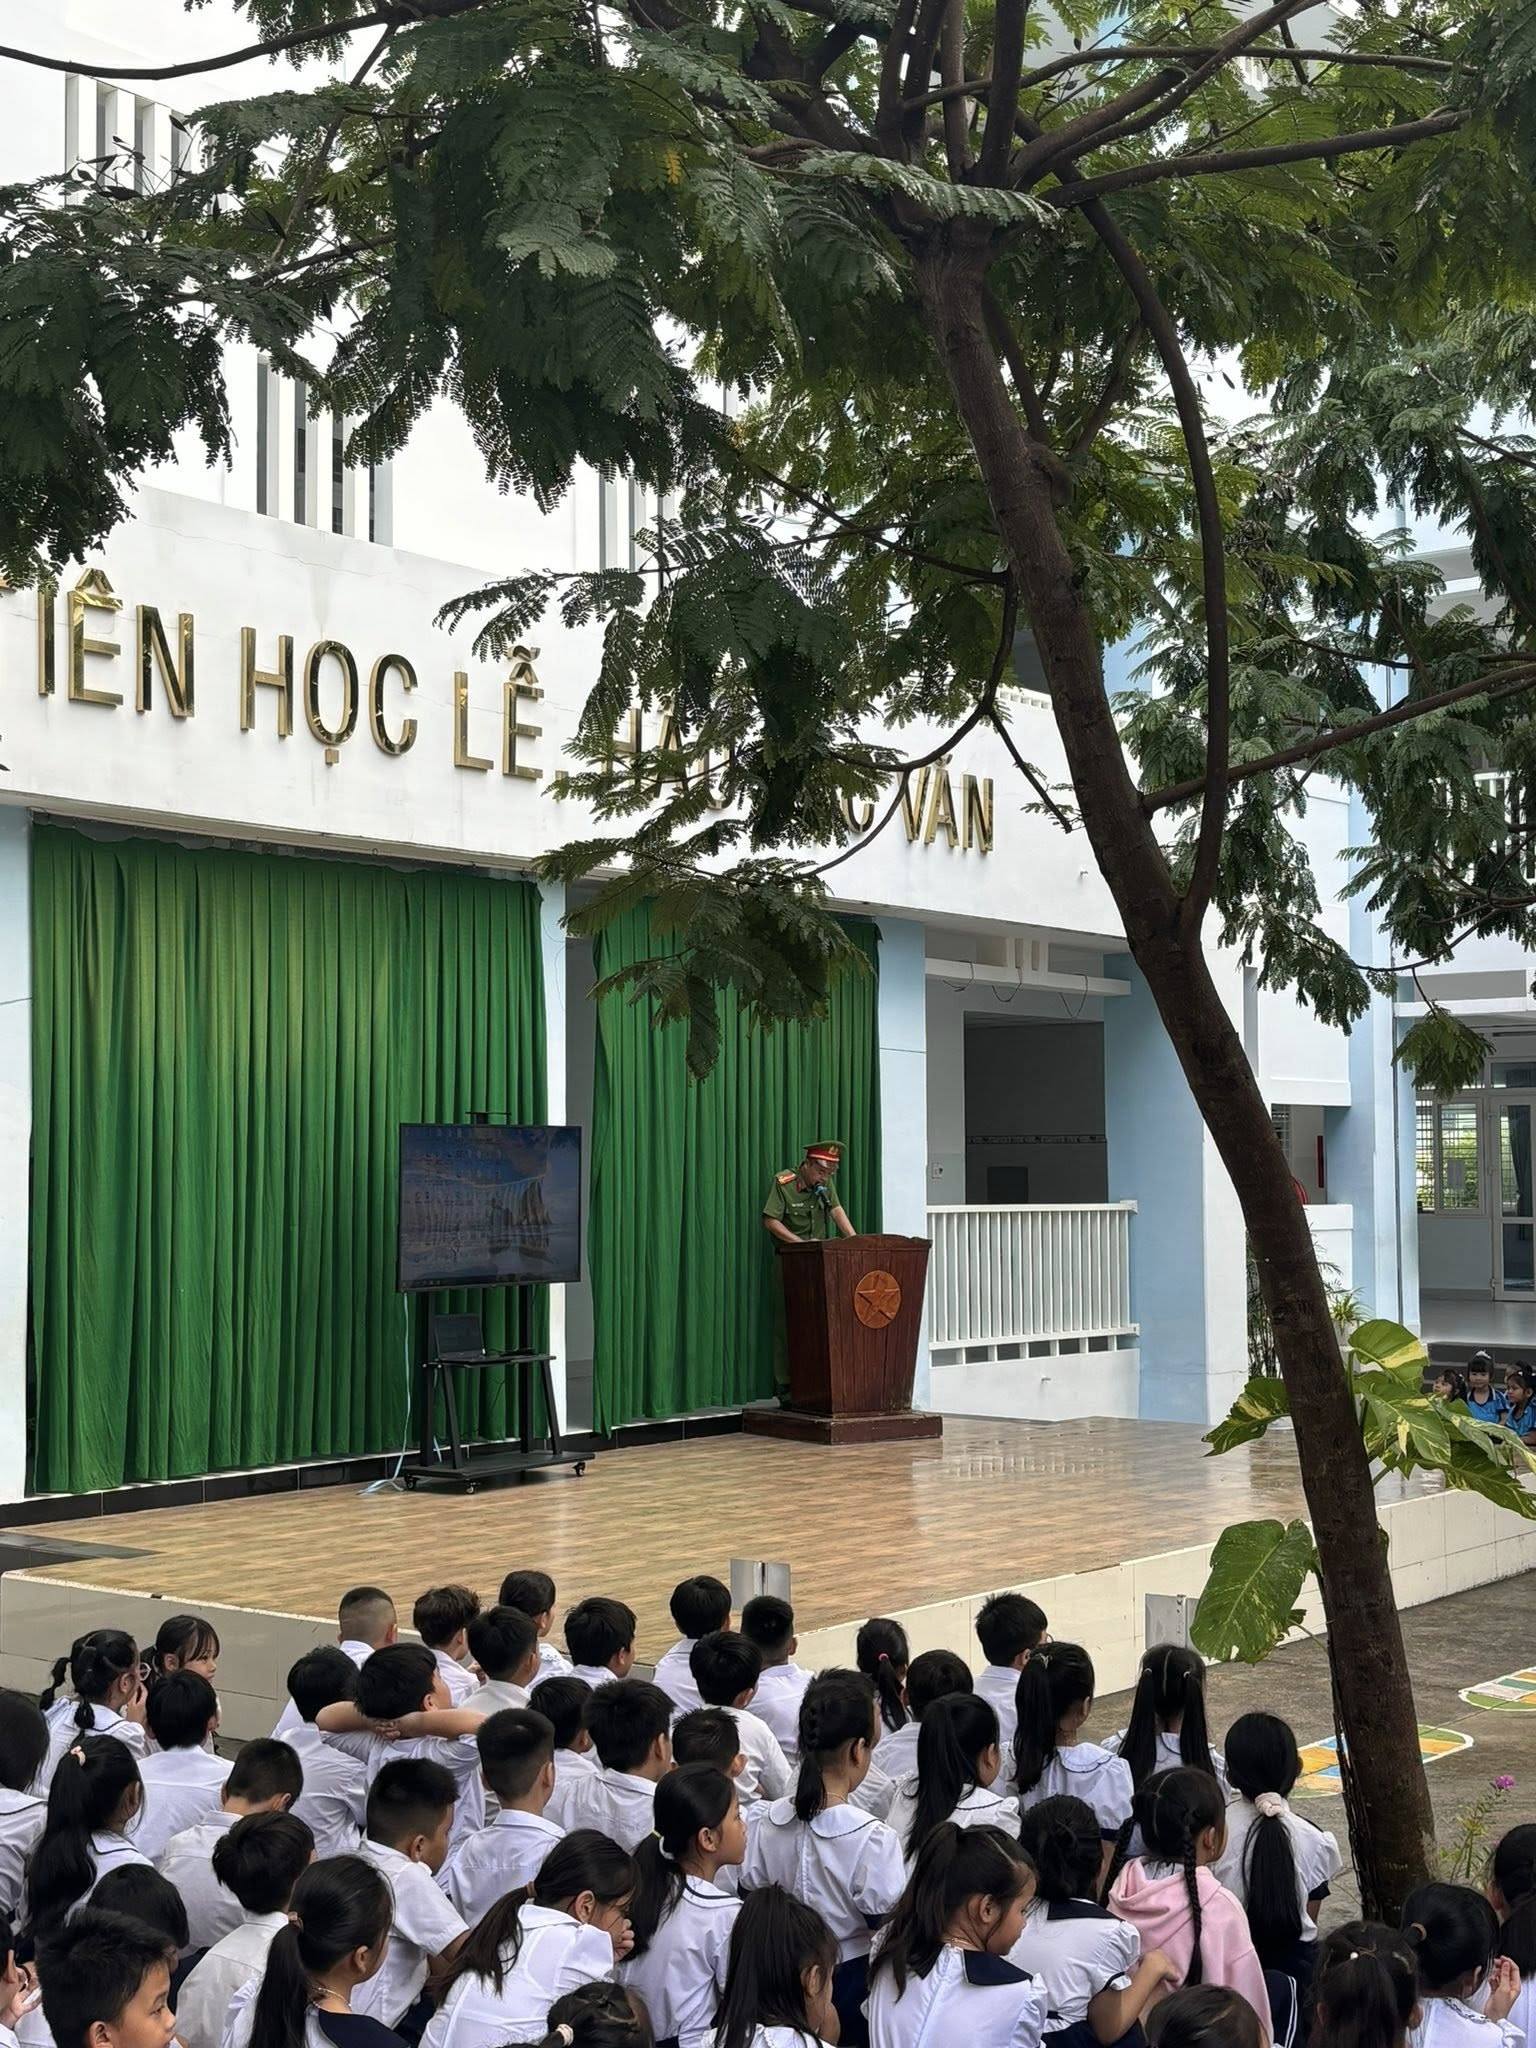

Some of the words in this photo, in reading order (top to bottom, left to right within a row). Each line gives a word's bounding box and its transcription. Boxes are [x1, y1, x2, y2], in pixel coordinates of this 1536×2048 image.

[0, 568, 195, 720] IÊN
[240, 626, 418, 767] HỌC
[897, 753, 993, 852] VĂN
